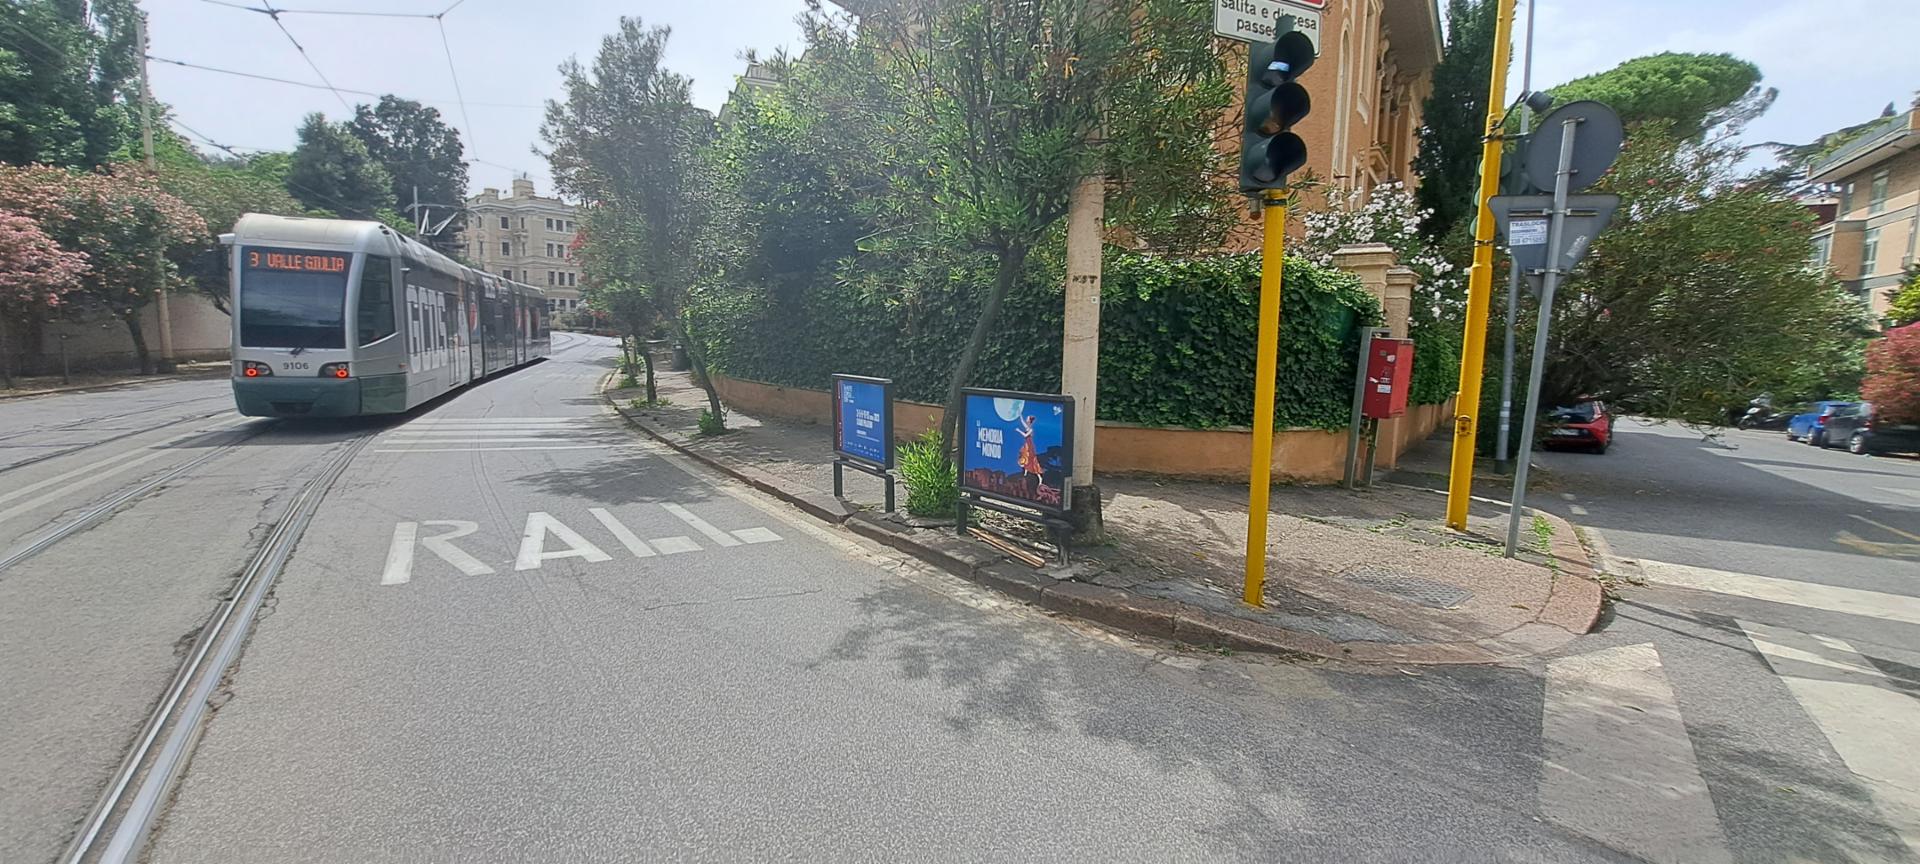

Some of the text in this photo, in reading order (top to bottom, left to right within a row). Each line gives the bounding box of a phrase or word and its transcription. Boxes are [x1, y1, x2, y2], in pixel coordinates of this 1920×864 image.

[1221, 0, 1256, 16] salita
[1261, 7, 1269, 18] e
[249, 251, 345, 272] 3 VALLE GIULIA
[283, 361, 309, 370] 9106
[977, 427, 1003, 445] MEMORIA
[981, 442, 1002, 459] MONDO
[380, 502, 785, 585] RALL
